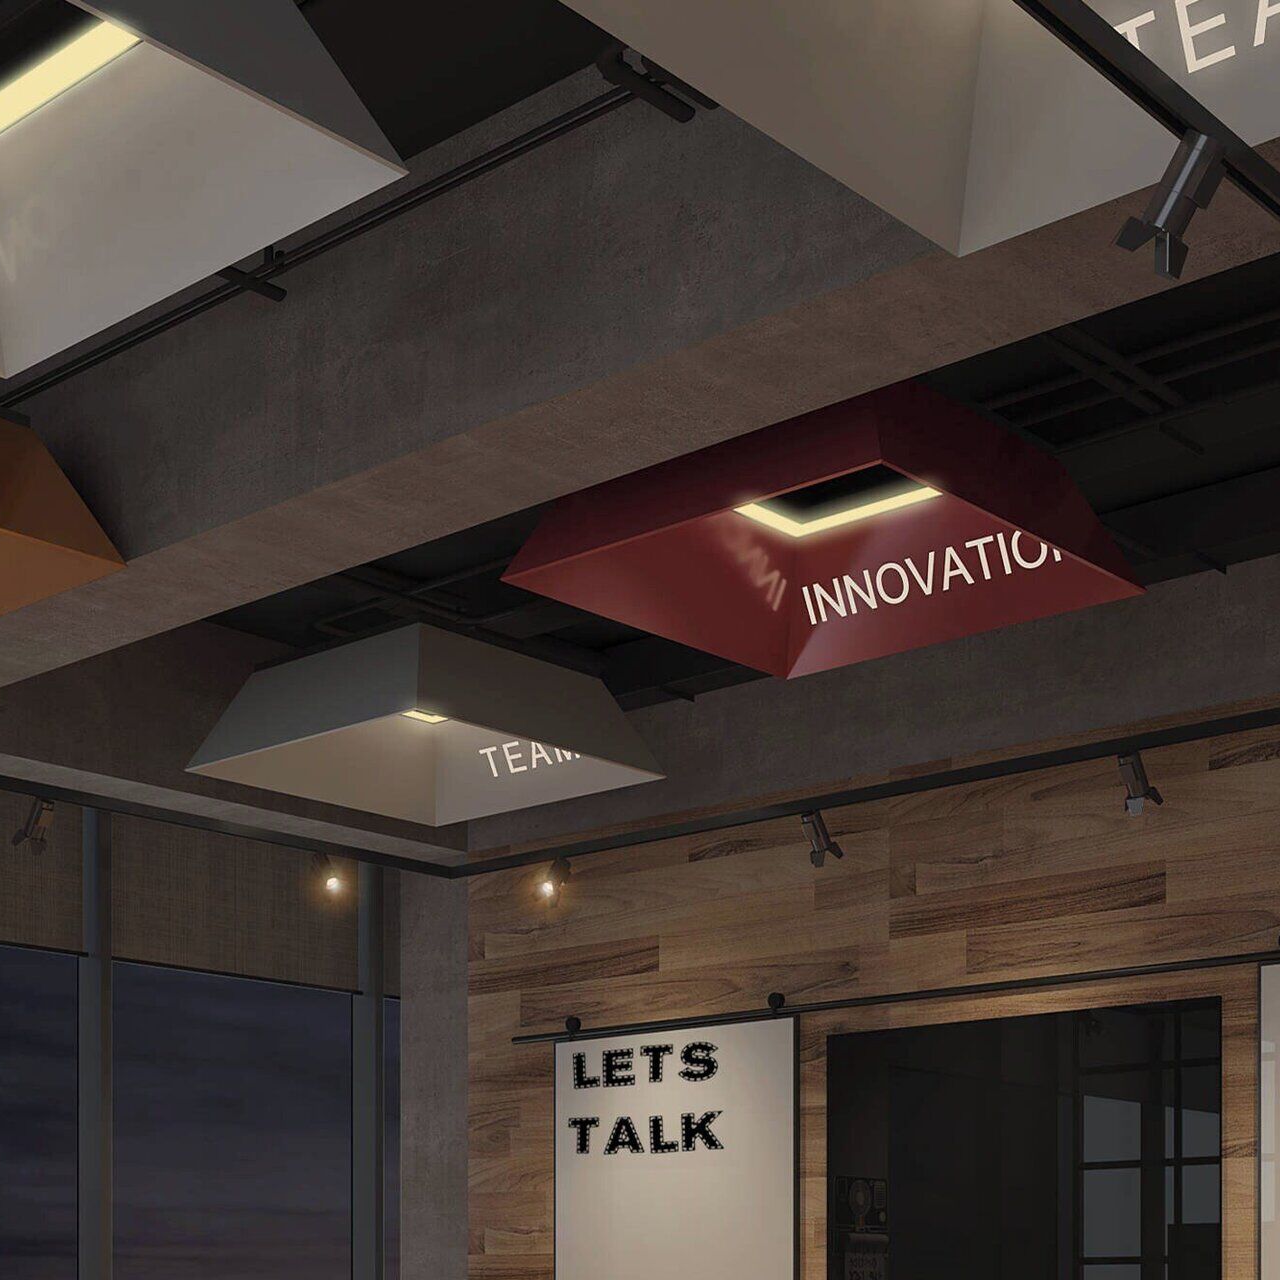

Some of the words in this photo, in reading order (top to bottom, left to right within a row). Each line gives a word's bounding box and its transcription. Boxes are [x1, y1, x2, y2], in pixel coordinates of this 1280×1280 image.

[802, 530, 1062, 625] INNOVATIO
[572, 1041, 719, 1089] LETS
[568, 1110, 724, 1155] TALK
